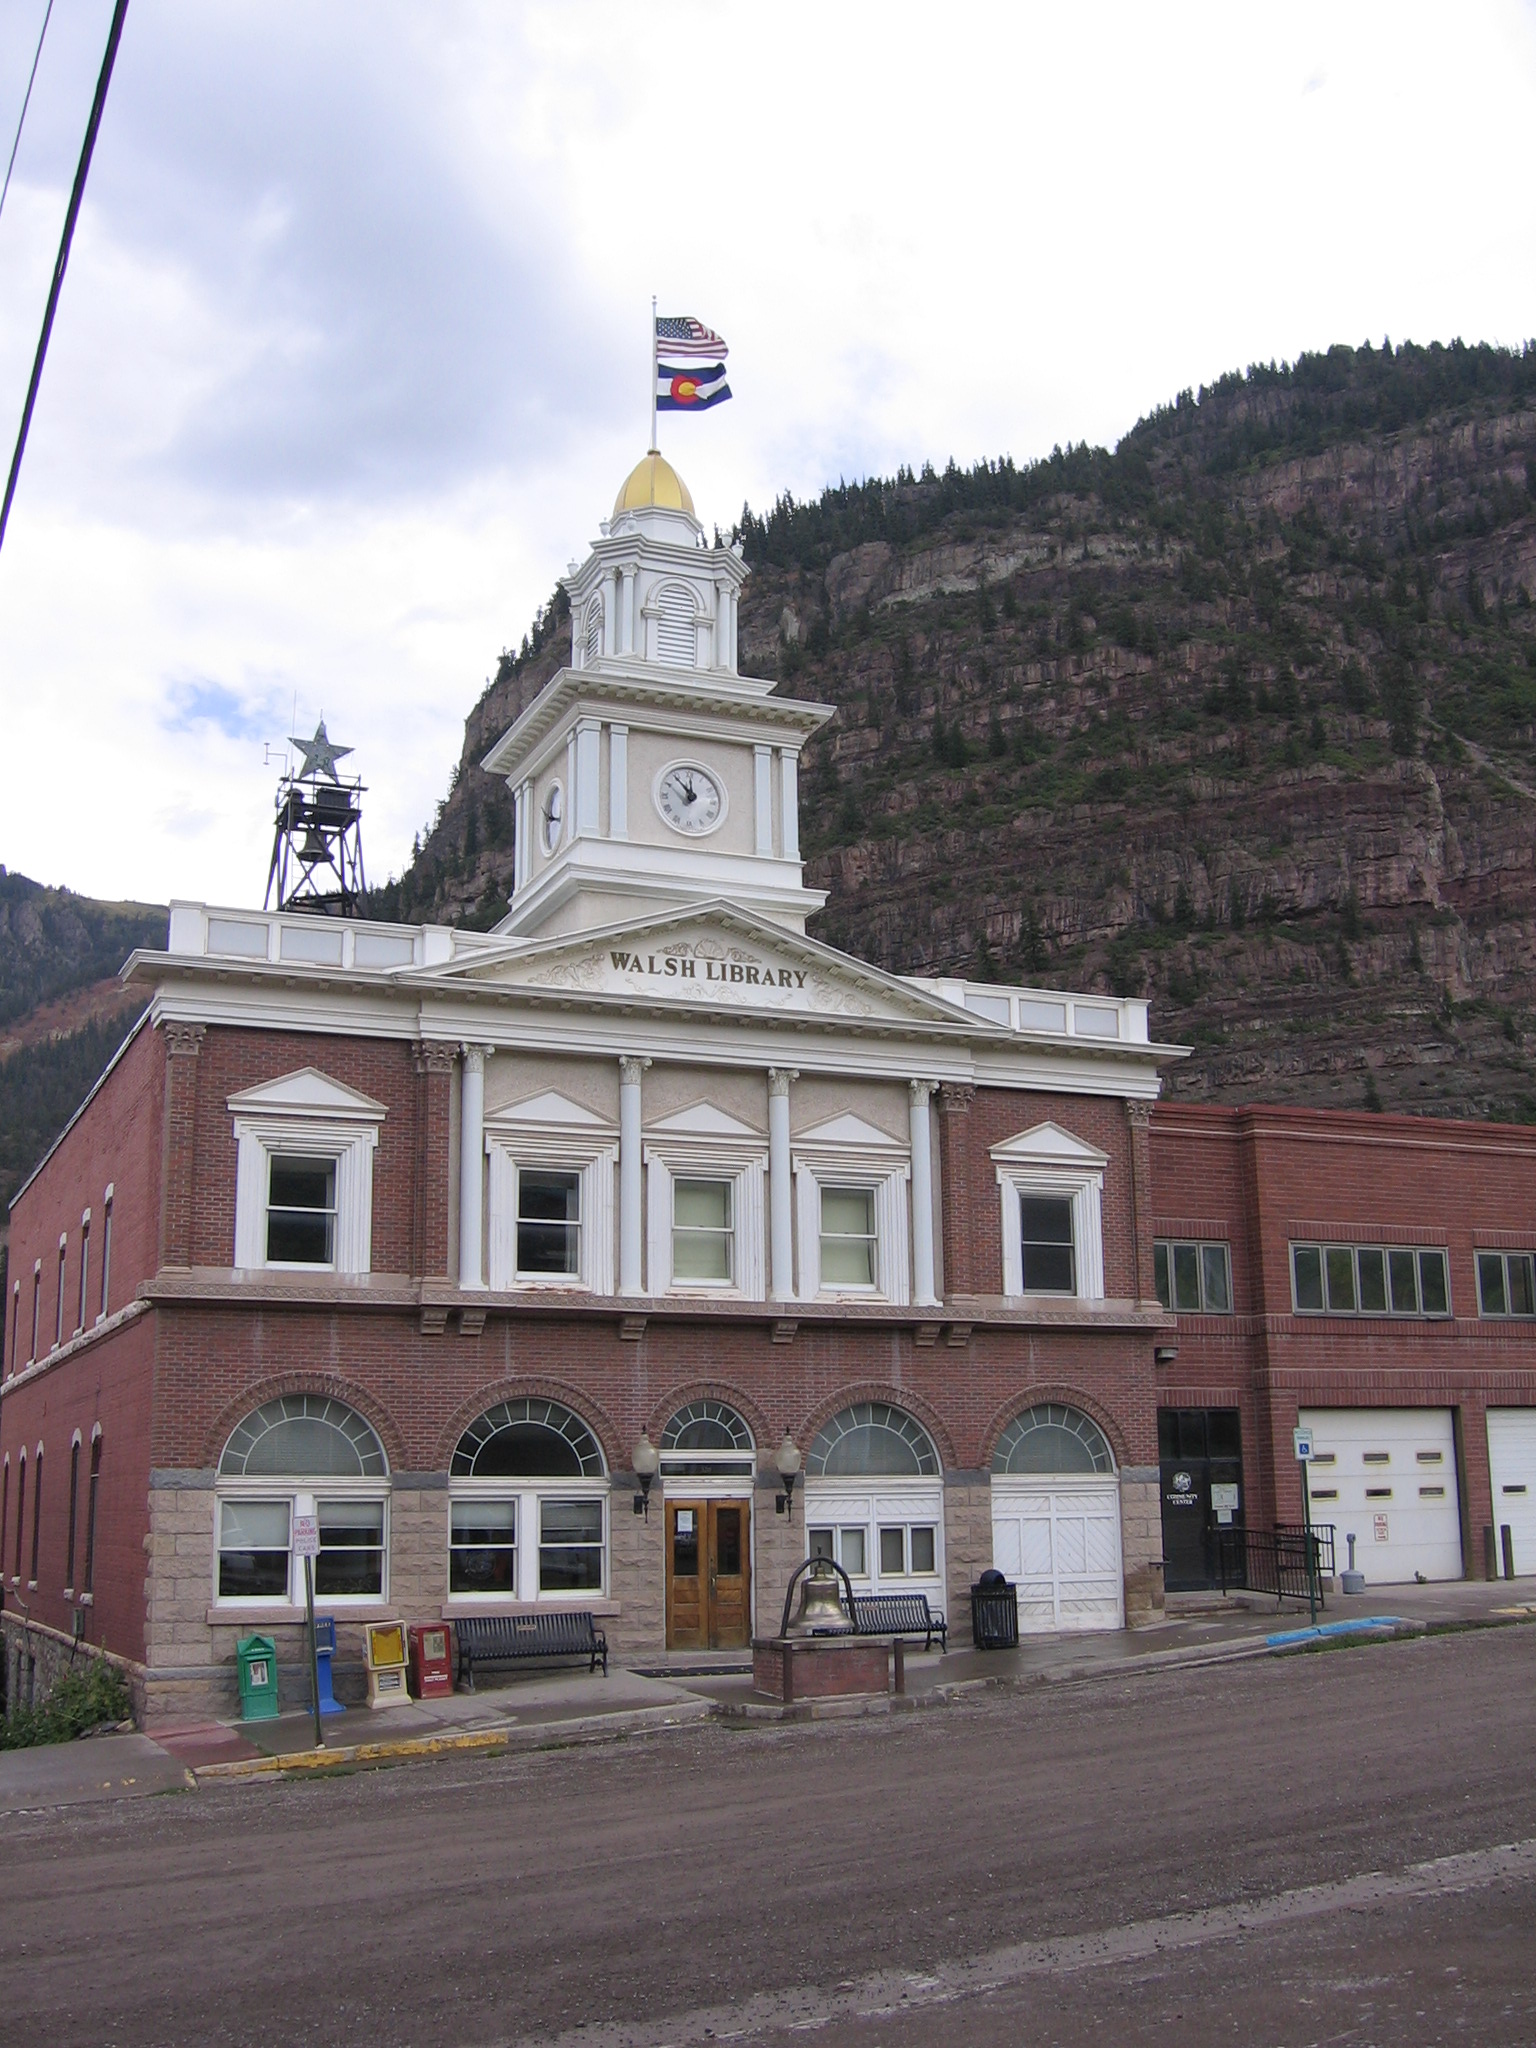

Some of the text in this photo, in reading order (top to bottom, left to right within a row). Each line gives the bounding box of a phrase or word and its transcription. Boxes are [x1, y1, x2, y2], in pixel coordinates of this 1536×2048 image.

[610, 951, 808, 989] WALSH LIBRARY
[300, 1519, 310, 1527] NO
[294, 1527, 317, 1536] PARKING
